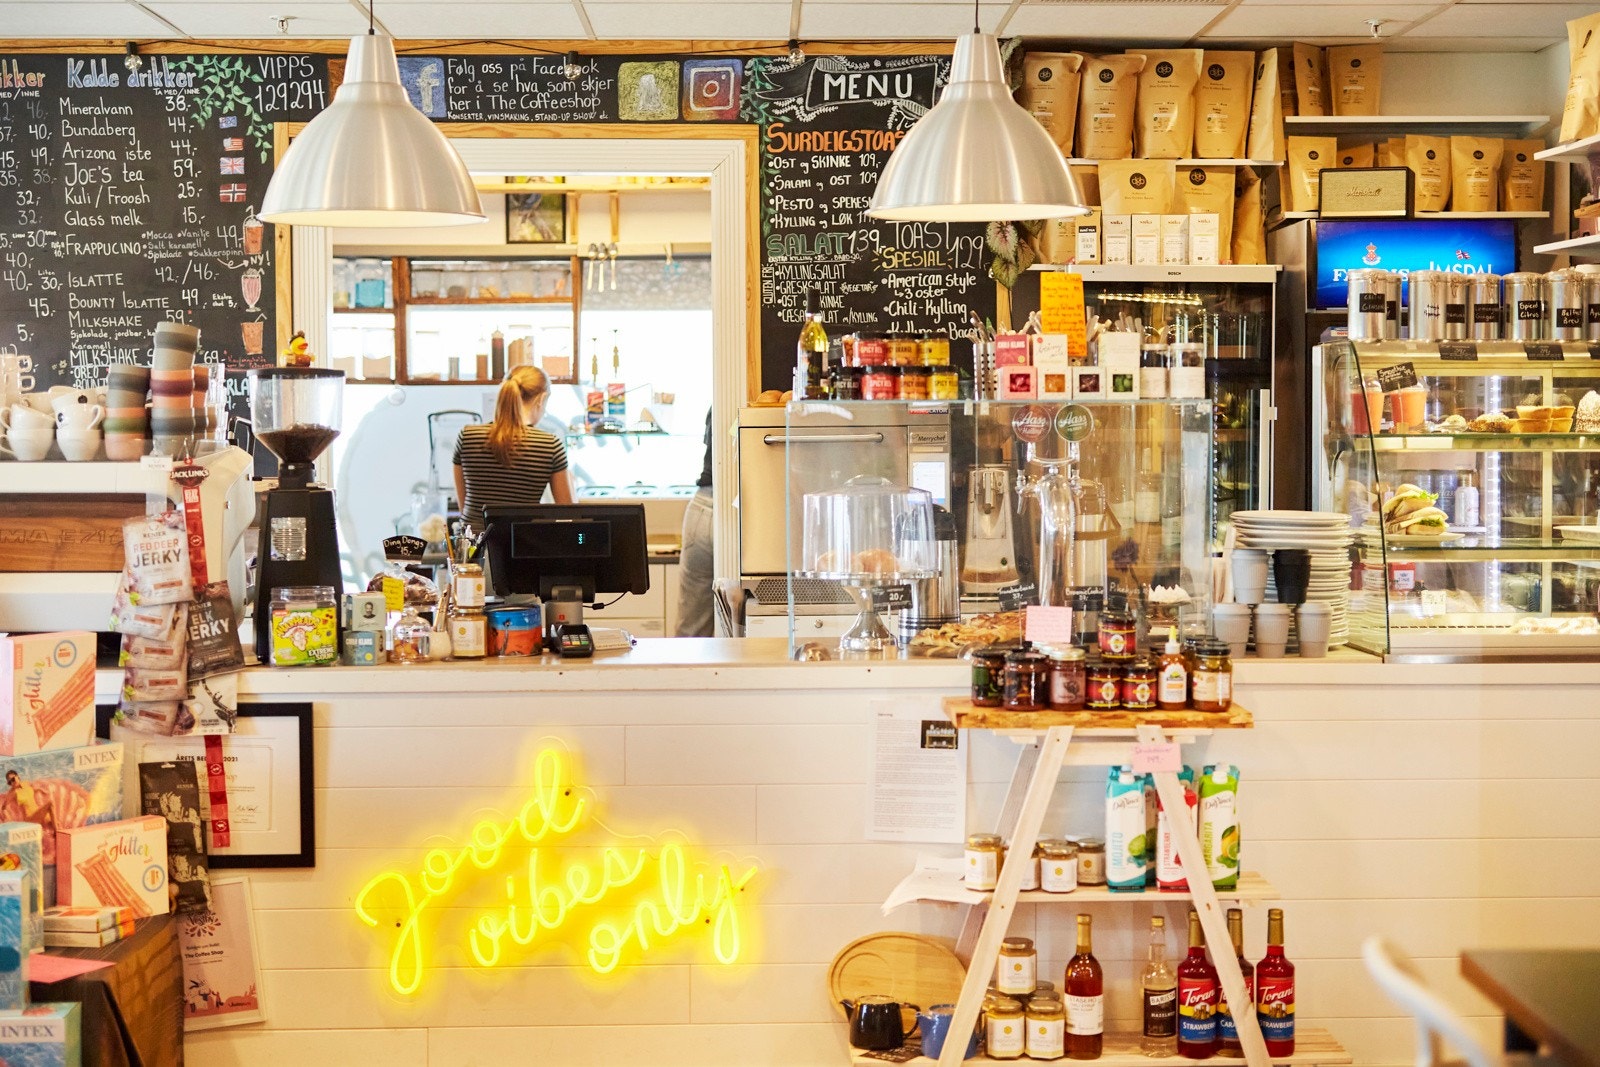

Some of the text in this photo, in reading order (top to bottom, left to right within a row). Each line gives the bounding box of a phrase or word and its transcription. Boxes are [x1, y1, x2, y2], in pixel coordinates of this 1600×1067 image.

[67, 58, 196, 88] Kalde drikker
[259, 56, 314, 79] VIPPS
[447, 57, 527, 82] Følg oss på
[448, 74, 614, 96] for å se hva som skjer
[823, 73, 913, 100] MENU
[60, 95, 191, 115] Mineralvann 38,-
[255, 79, 325, 113] 129294
[449, 92, 601, 112] her i The Coffeeshop
[535, 112, 570, 121] STAND-UP
[573, 112, 597, 120] SHOW
[29, 124, 52, 140] 40,-
[61, 116, 194, 146] Bundaberg 44,-
[31, 147, 54, 166] 49,-
[62, 139, 197, 160] Arizona iste 44,-
[65, 158, 201, 186] JOE'S tea 59,-
[773, 153, 881, 174] OST og SKINKE 109,-
[774, 175, 811, 190] SALAMI
[829, 175, 852, 186] OST
[16, 190, 41, 206] 32,-
[65, 181, 202, 205] Kuli Froosh 25,-
[775, 195, 814, 211] PESTO
[819, 204, 828, 213] og
[65, 206, 205, 227] Glass melk 15,-
[775, 213, 853, 229] KYLLING og LØK
[66, 234, 141, 255] FRAPPUCINO
[147, 229, 210, 241] Mocca Vanilje
[148, 225, 245, 249] Salt karamell 49,-
[767, 229, 885, 256] SALAT 139,-
[886, 220, 949, 250] TOAST
[6, 252, 34, 269] 40,-
[193, 247, 243, 260] Sukkerspinn
[250, 250, 271, 267] NY!
[882, 247, 946, 268] SPESIAL
[4, 270, 63, 291] 40,- 30,-
[69, 272, 124, 288] ISLATTE
[779, 263, 846, 280] KYLLINGSALAT
[888, 272, 976, 294] American Style
[904, 286, 948, 299] 3 oster
[28, 297, 56, 318] 45,-
[69, 293, 115, 309] BOUNTY
[123, 291, 169, 309] ISLATTE
[781, 295, 845, 308] OST KINKE
[68, 311, 142, 328] MILKSHAKE
[17, 324, 35, 341] 5,-
[70, 348, 142, 366] MILKSHAKE
[74, 366, 98, 379] OREO
[154, 539, 179, 549] DEER
[384, 536, 424, 550] Ding Dongs
[133, 549, 181, 568] JERKY
[191, 611, 213, 625] ELK
[188, 618, 230, 640] ERKY
[79, 750, 118, 766] INTEX
[109, 836, 150, 864] glitter
[1112, 832, 1123, 866] MOJITO
[470, 848, 646, 967] vibes
[588, 843, 759, 975] only
[1260, 984, 1294, 1005] Torani
[2, 1026, 53, 1037] INTEX
